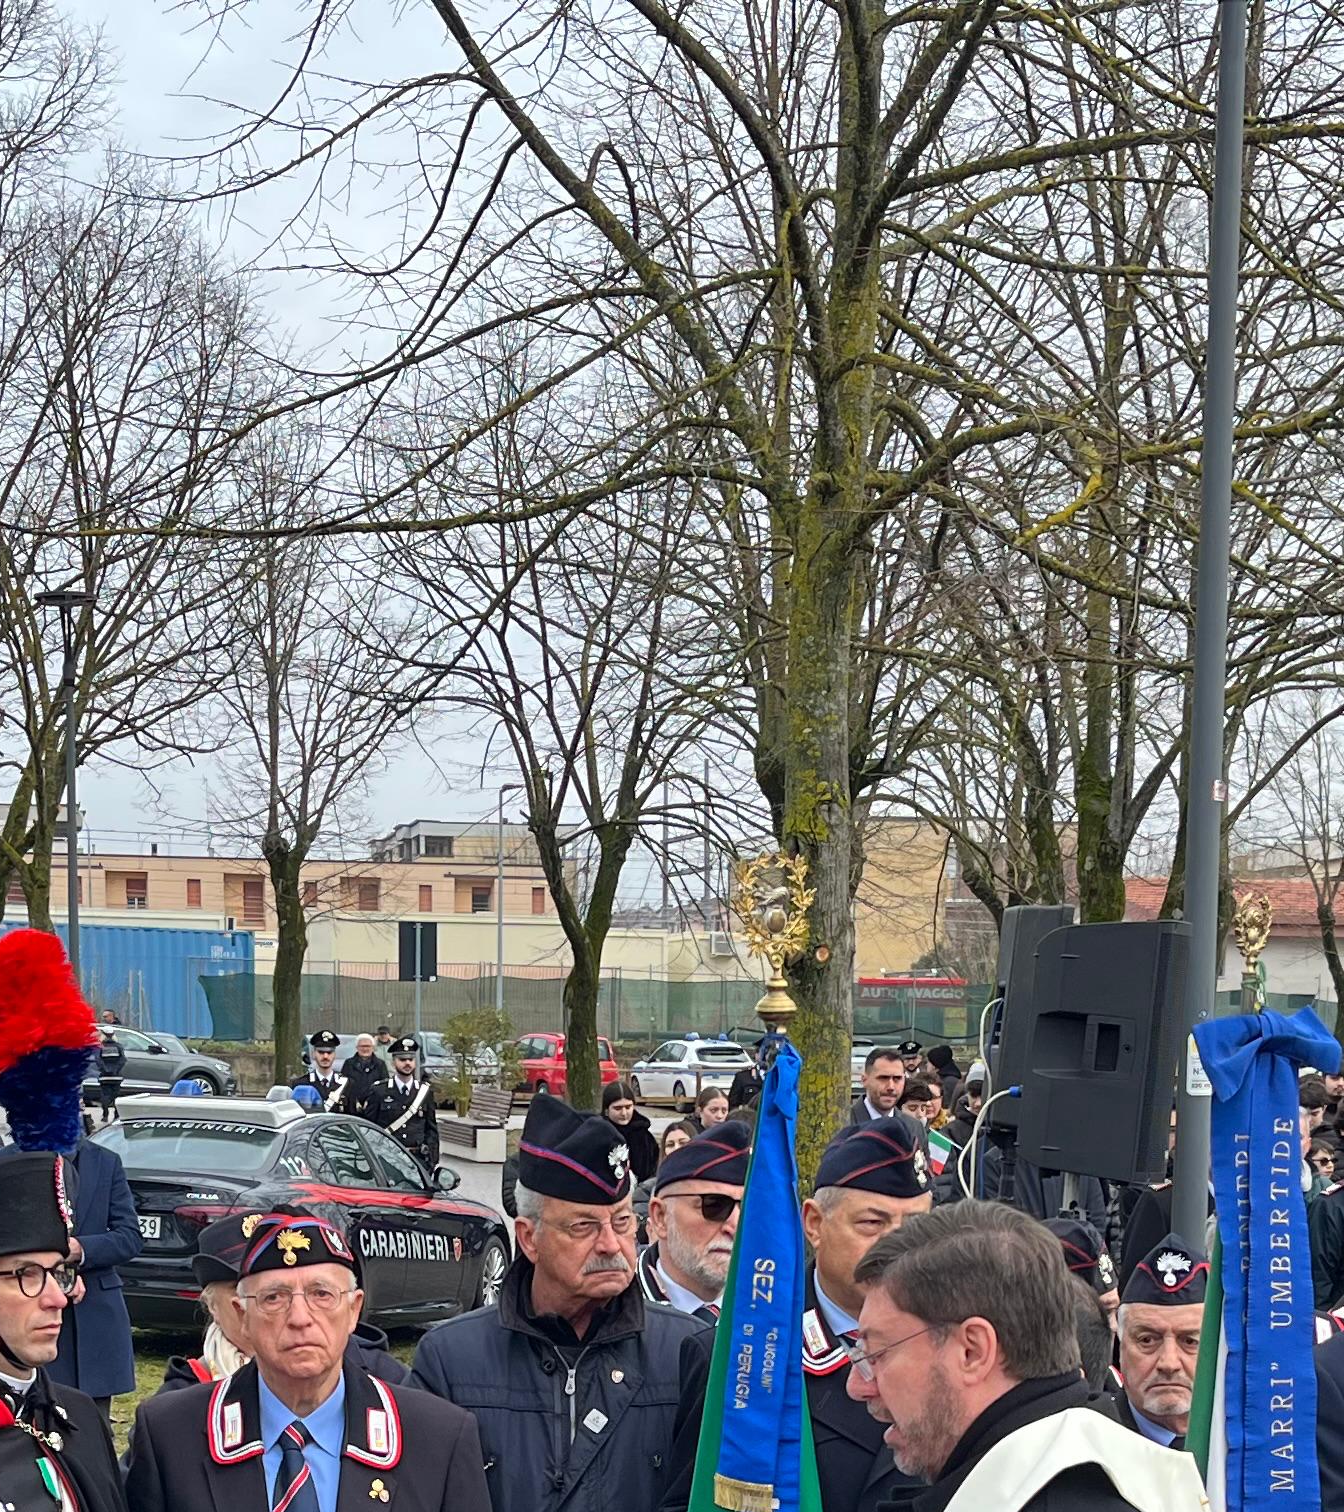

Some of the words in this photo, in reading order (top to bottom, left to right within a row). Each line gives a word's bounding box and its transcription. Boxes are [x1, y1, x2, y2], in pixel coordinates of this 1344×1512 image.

[279, 1156, 312, 1179] 112
[360, 1228, 449, 1261] CARABINIERI
[1269, 1117, 1294, 1329] UMBERTIDE
[750, 1257, 776, 1311] SEZ.
[733, 1343, 754, 1409] PERUGIA
